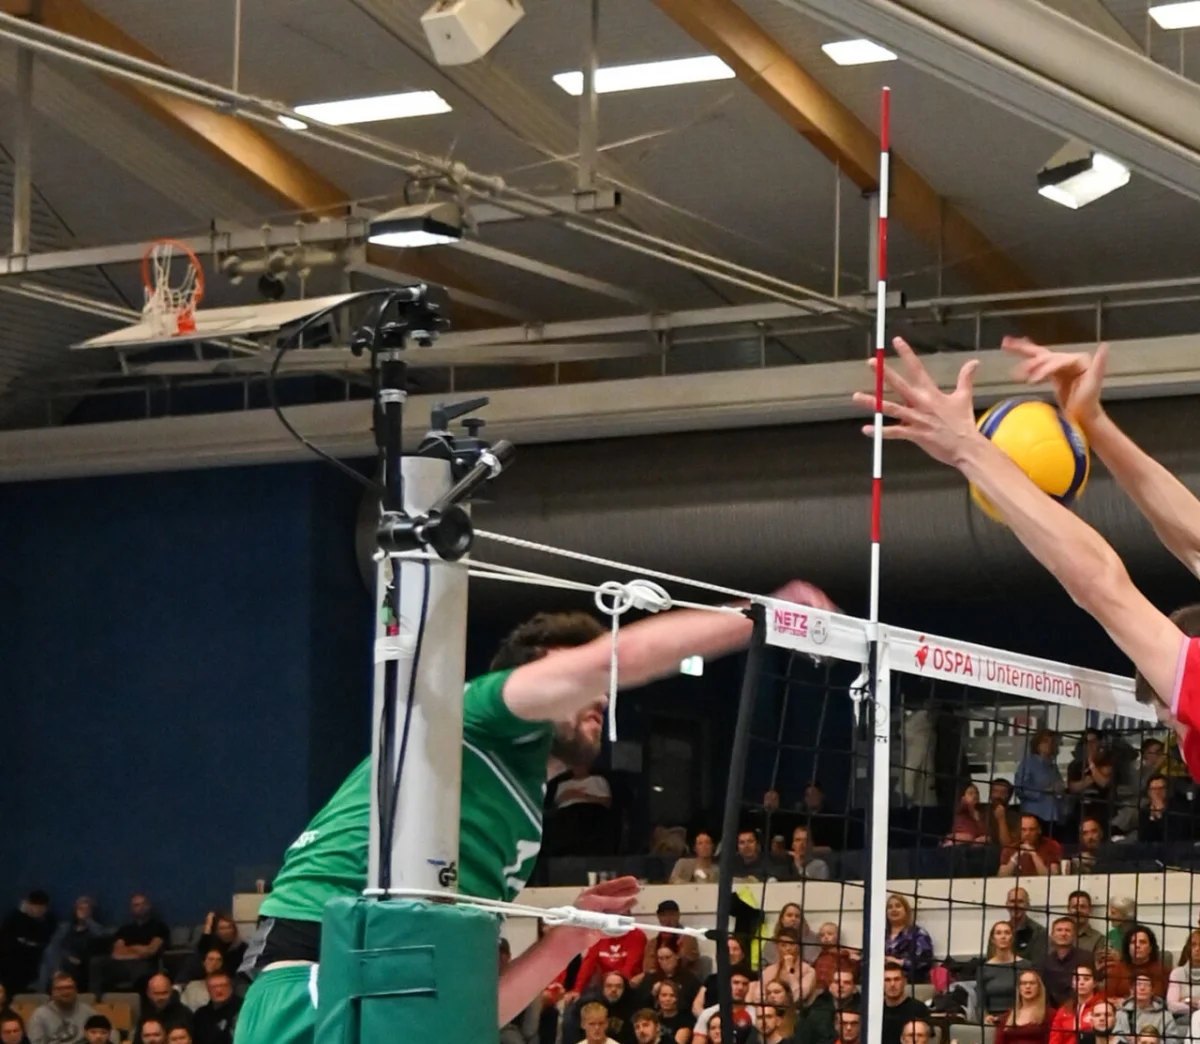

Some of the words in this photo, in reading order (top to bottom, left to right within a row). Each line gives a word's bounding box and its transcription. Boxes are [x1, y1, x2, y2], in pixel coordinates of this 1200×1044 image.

[774, 609, 808, 630] NETZ
[933, 648, 973, 677] OSPA
[987, 659, 1081, 699] Unternehmen
